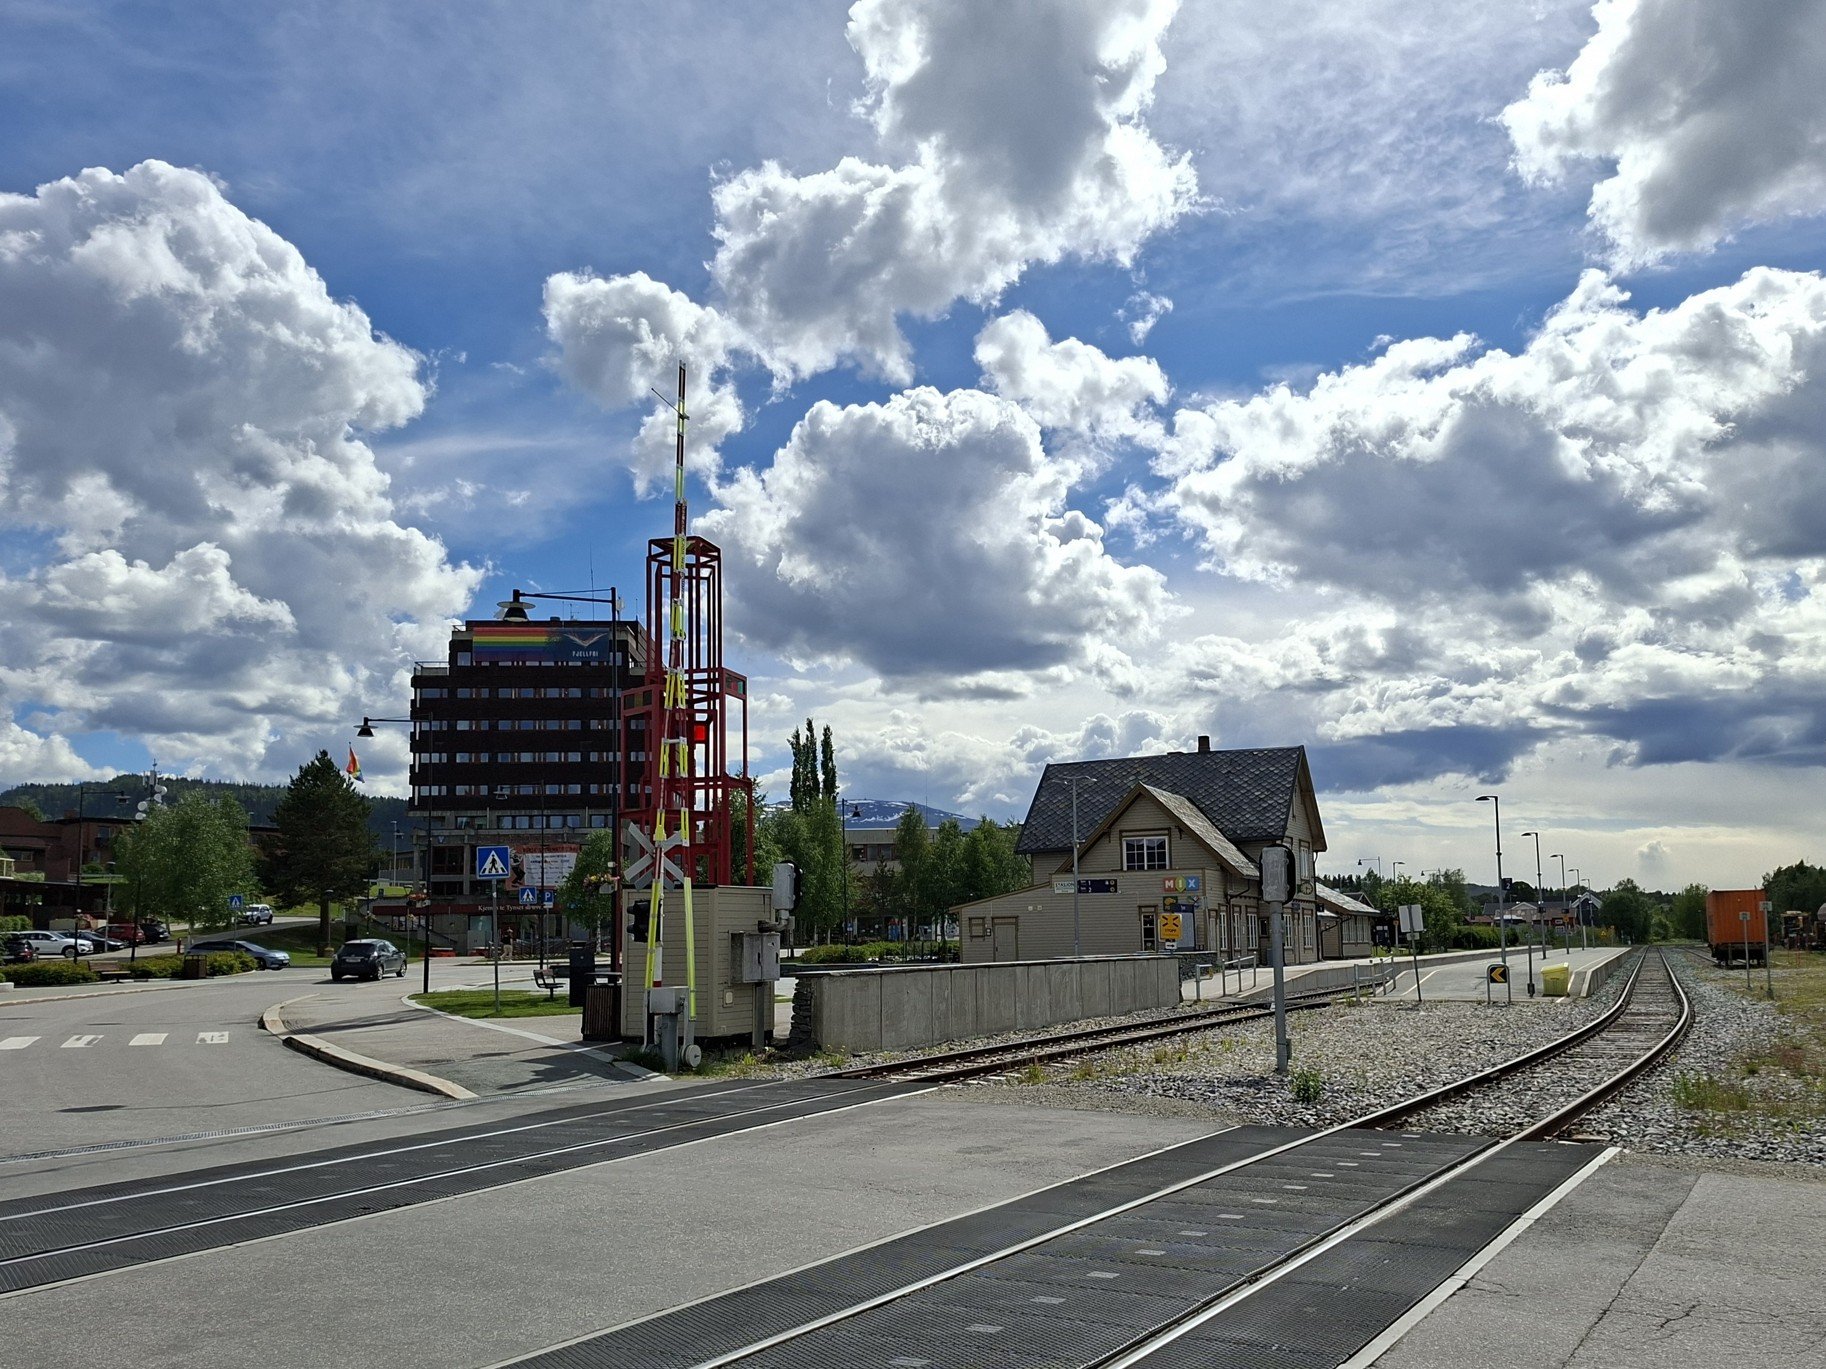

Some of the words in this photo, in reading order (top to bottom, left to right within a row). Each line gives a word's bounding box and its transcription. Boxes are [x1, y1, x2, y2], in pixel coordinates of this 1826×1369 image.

[1165, 879, 1196, 889] MIX
[1506, 882, 1511, 890] 2
[545, 891, 551, 901] P
